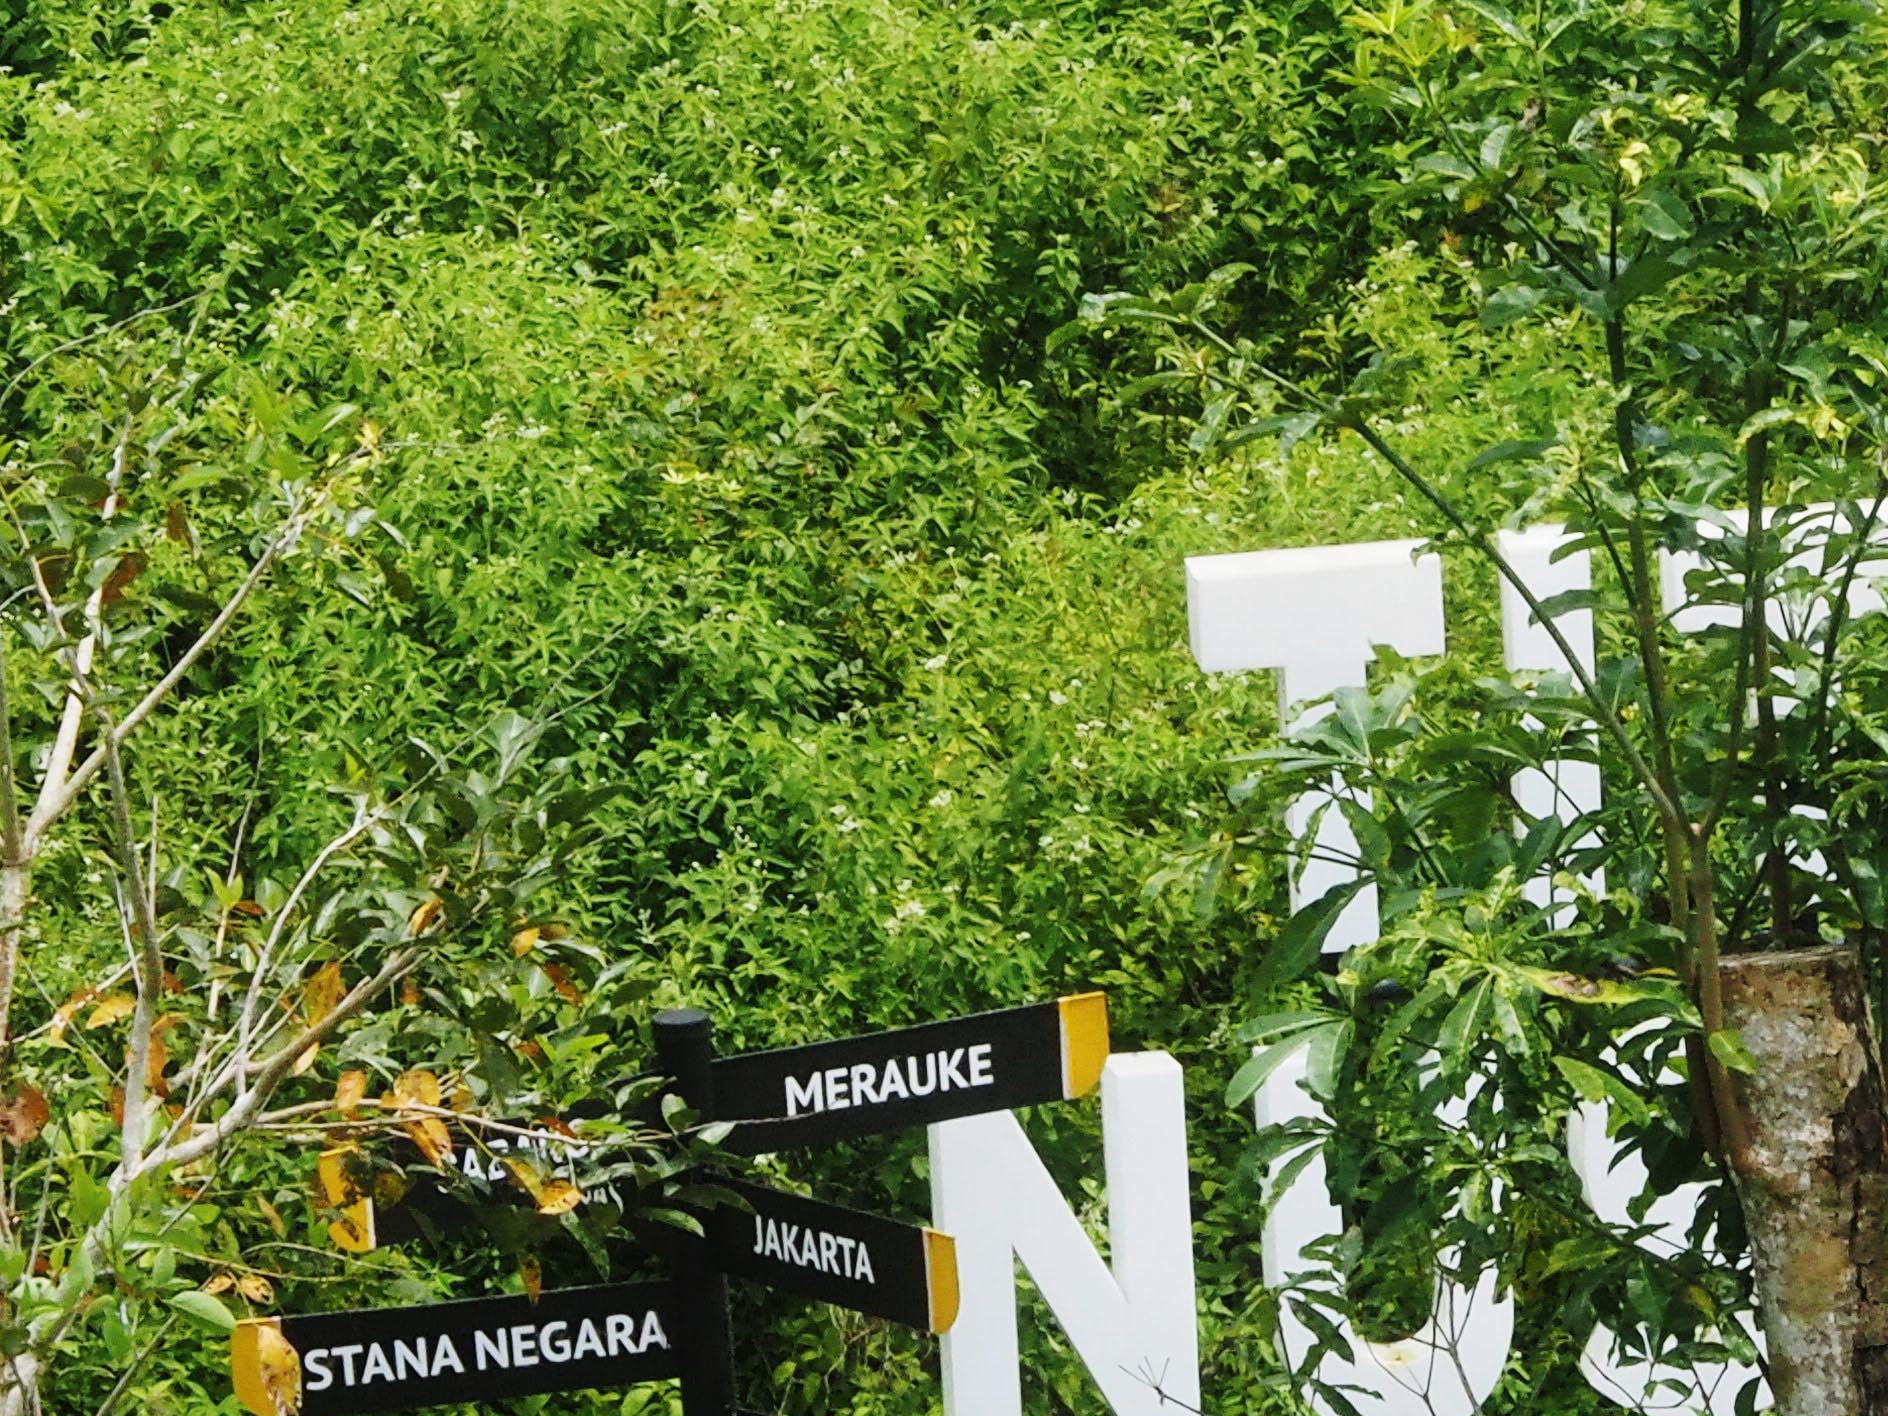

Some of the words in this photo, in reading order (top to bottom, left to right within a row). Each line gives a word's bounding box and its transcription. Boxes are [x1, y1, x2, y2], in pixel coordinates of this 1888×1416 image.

[784, 1043, 995, 1117] MERAUKE
[753, 1214, 876, 1285] JAKARTA
[473, 1309, 670, 1371] NEGARA
